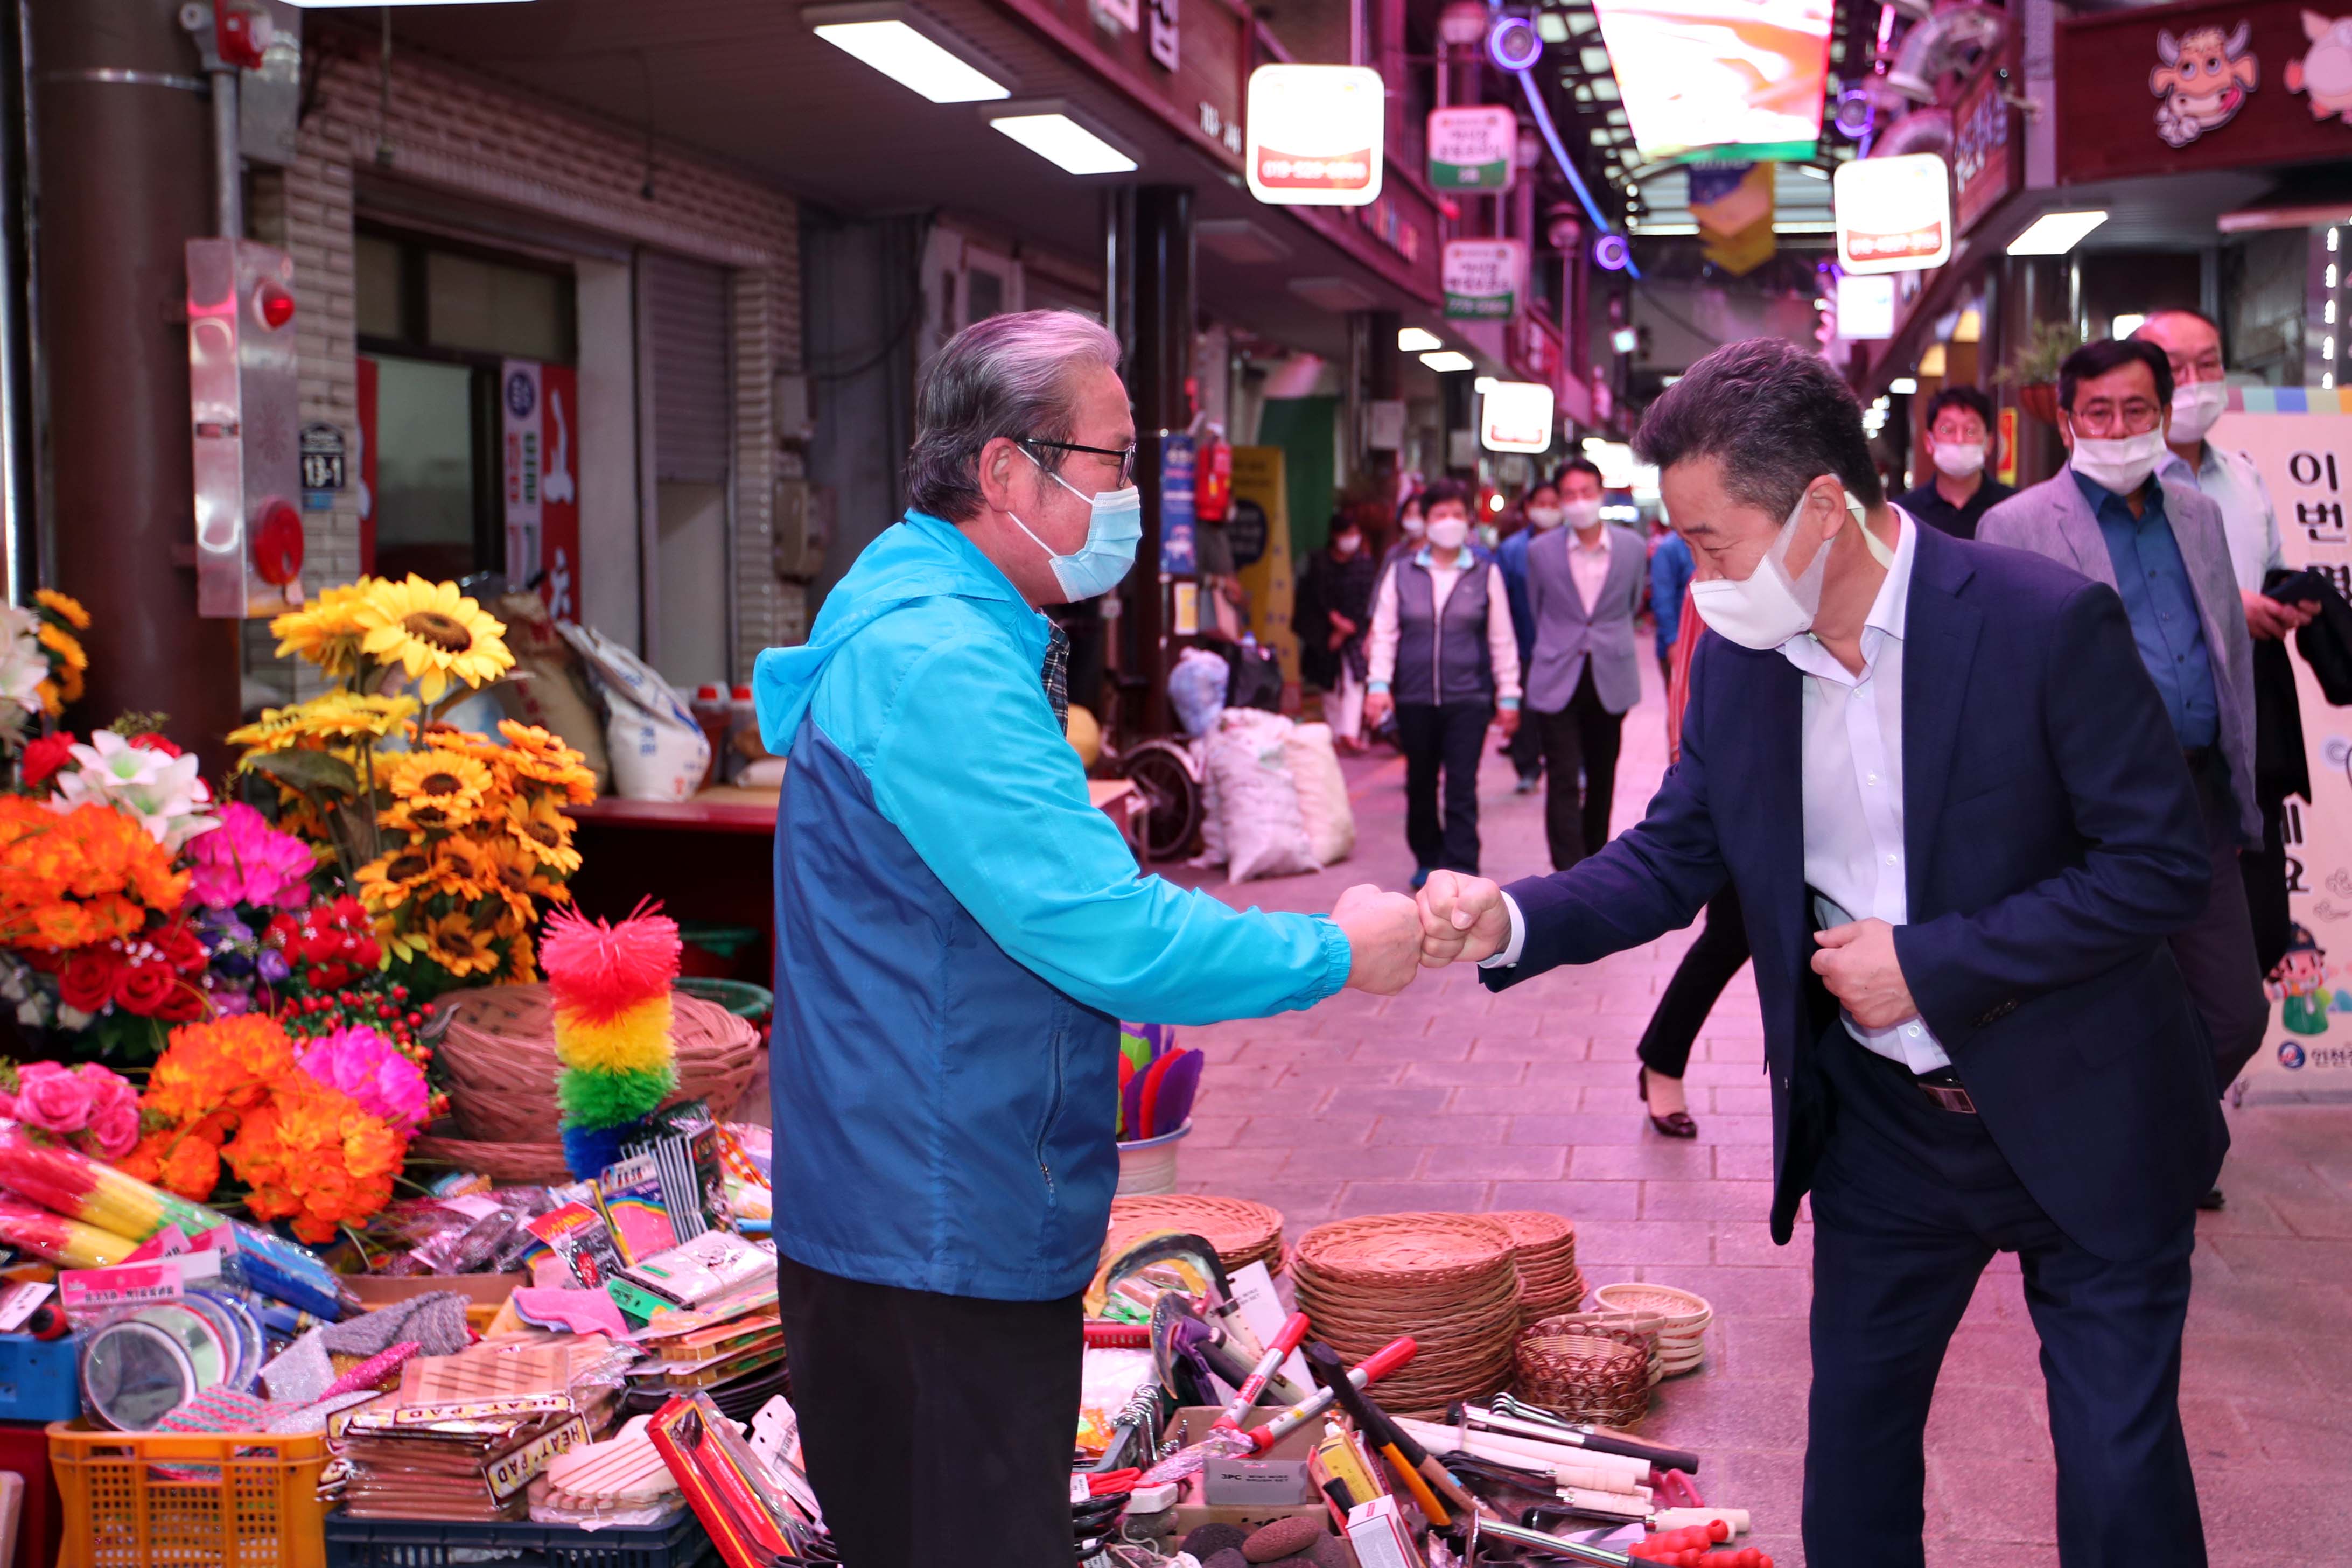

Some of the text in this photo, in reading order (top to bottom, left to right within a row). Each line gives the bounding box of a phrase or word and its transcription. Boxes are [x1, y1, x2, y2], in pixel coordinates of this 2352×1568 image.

[304, 455, 342, 487] 13-1
[2311, 1048, 2351, 1068] 인천
[409, 1406, 465, 1418] PAD
[498, 1453, 528, 1483] PAD
